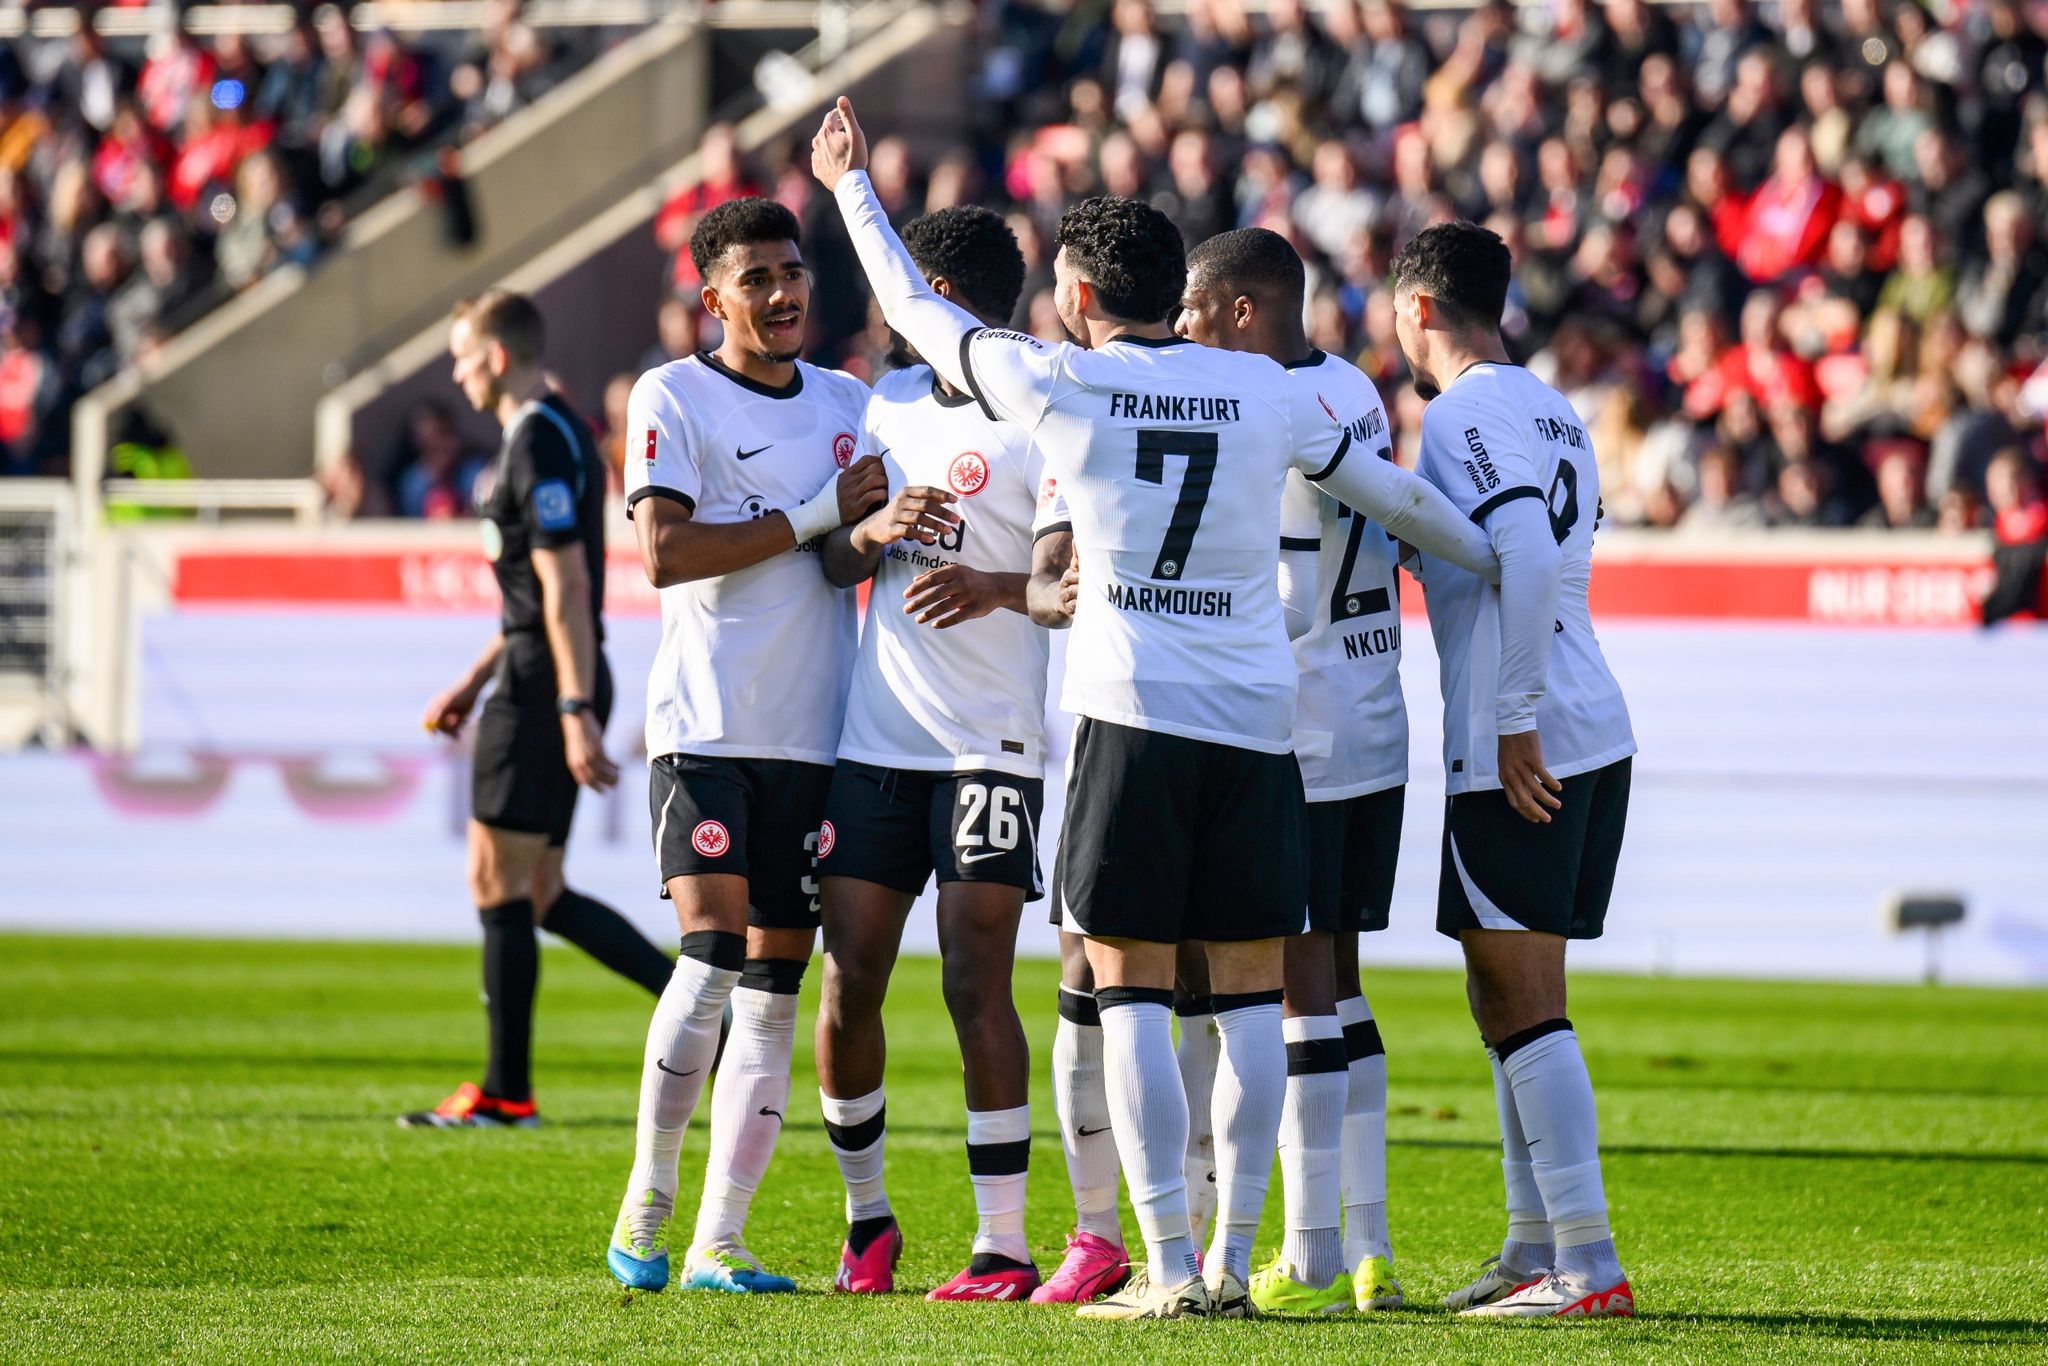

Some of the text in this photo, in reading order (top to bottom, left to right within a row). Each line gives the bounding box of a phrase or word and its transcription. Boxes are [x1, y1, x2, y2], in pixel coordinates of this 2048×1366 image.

[1109, 393, 1241, 421] FRANKFURT
[1464, 427, 1501, 490] ELOTRANS
[1463, 459, 1489, 495] reload
[1134, 429, 1219, 581] 7
[886, 544, 908, 562] Jobs
[1107, 583, 1232, 617] MARMOUSH
[955, 783, 1020, 850] 26
